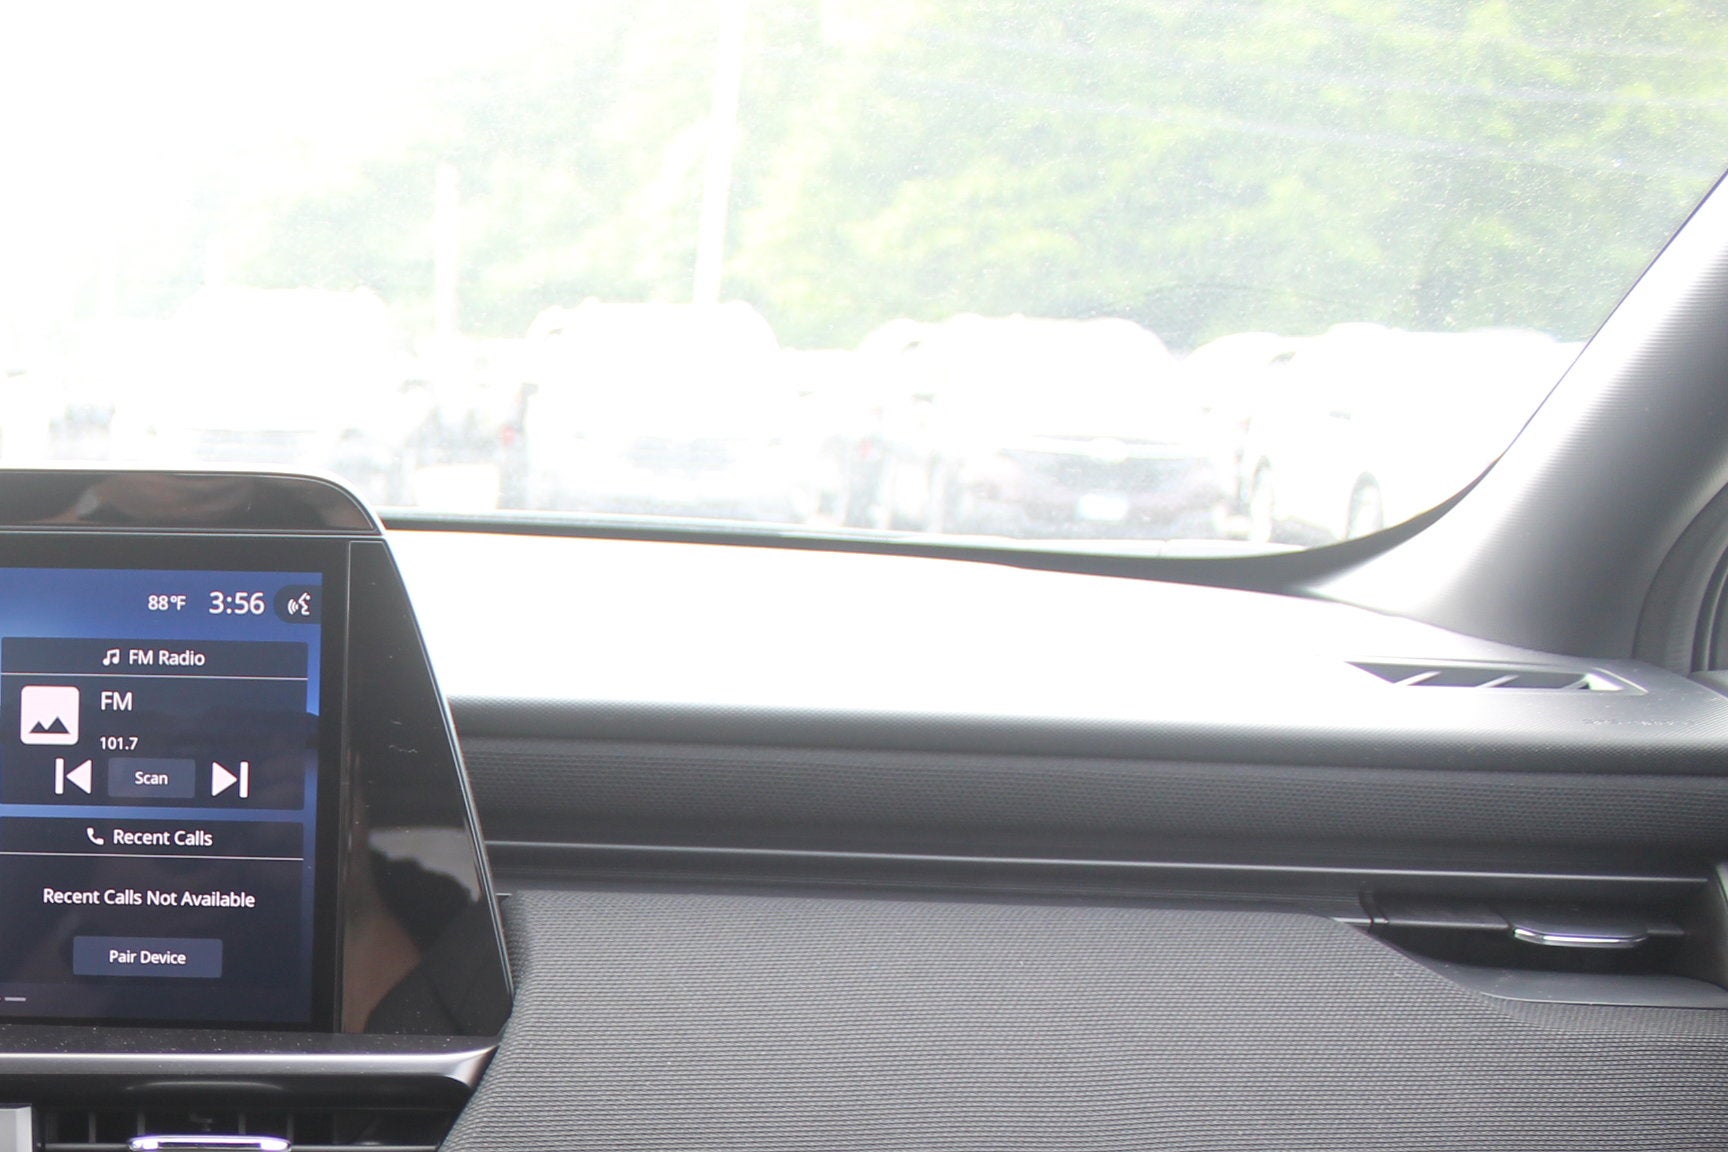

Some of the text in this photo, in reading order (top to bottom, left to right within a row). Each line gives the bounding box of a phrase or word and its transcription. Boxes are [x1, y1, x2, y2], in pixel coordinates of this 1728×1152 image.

[148, 591, 265, 615] 88°F 3:56
[129, 650, 206, 666] FM Radio
[100, 691, 133, 711] FM
[99, 737, 138, 751] 101.7
[134, 771, 168, 785] Scan
[113, 829, 213, 847] Recent Calls
[43, 888, 256, 908] Recent Calls Not Available
[109, 950, 186, 965] Pair Device
